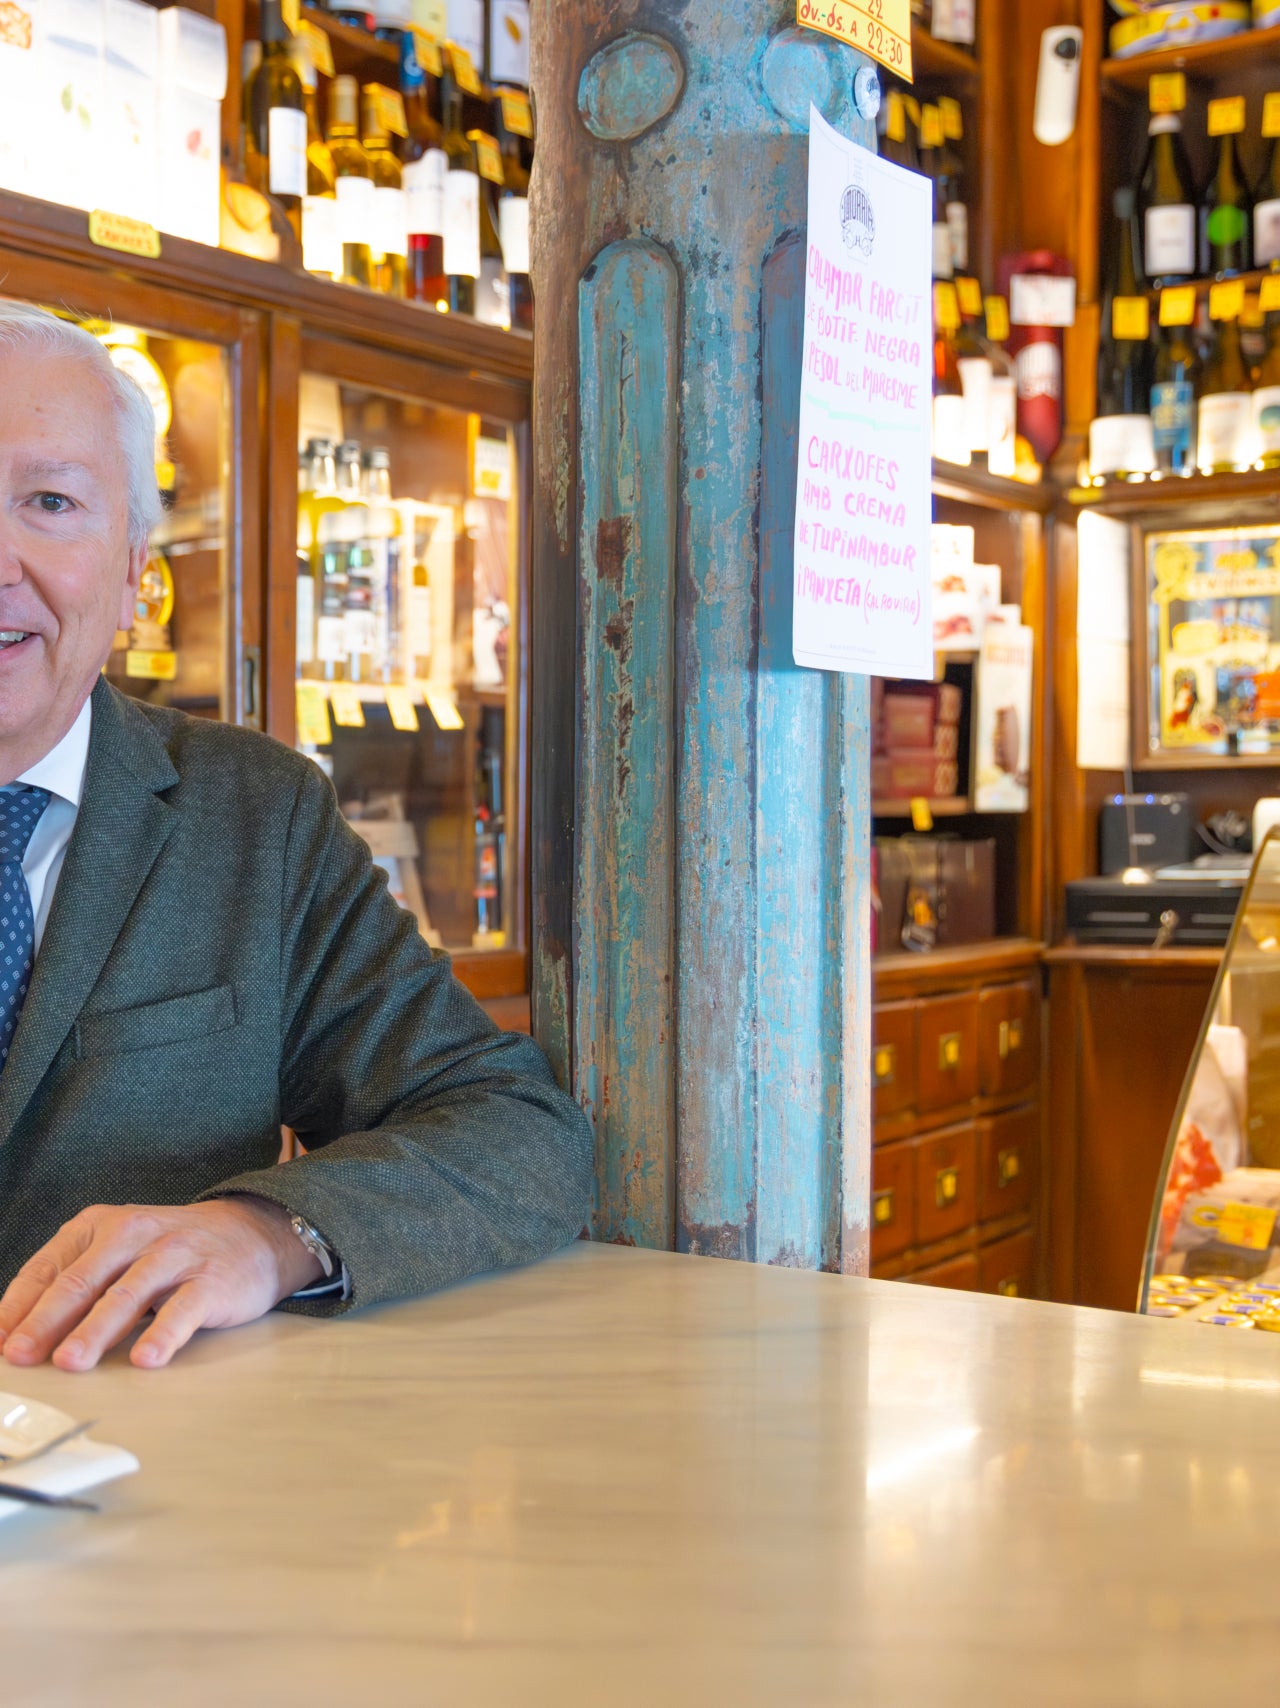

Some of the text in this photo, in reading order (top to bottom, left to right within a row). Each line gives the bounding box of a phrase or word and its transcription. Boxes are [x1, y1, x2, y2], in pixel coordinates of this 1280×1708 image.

[850, 21, 858, 38] A
[867, 22, 903, 65] 22:30
[808, 244, 863, 312] CALAMAR
[865, 328, 921, 368] NEGRA
[862, 365, 919, 410] MARESME
[807, 435, 899, 492] CARXOFES
[803, 477, 906, 528] AMB CREMA
